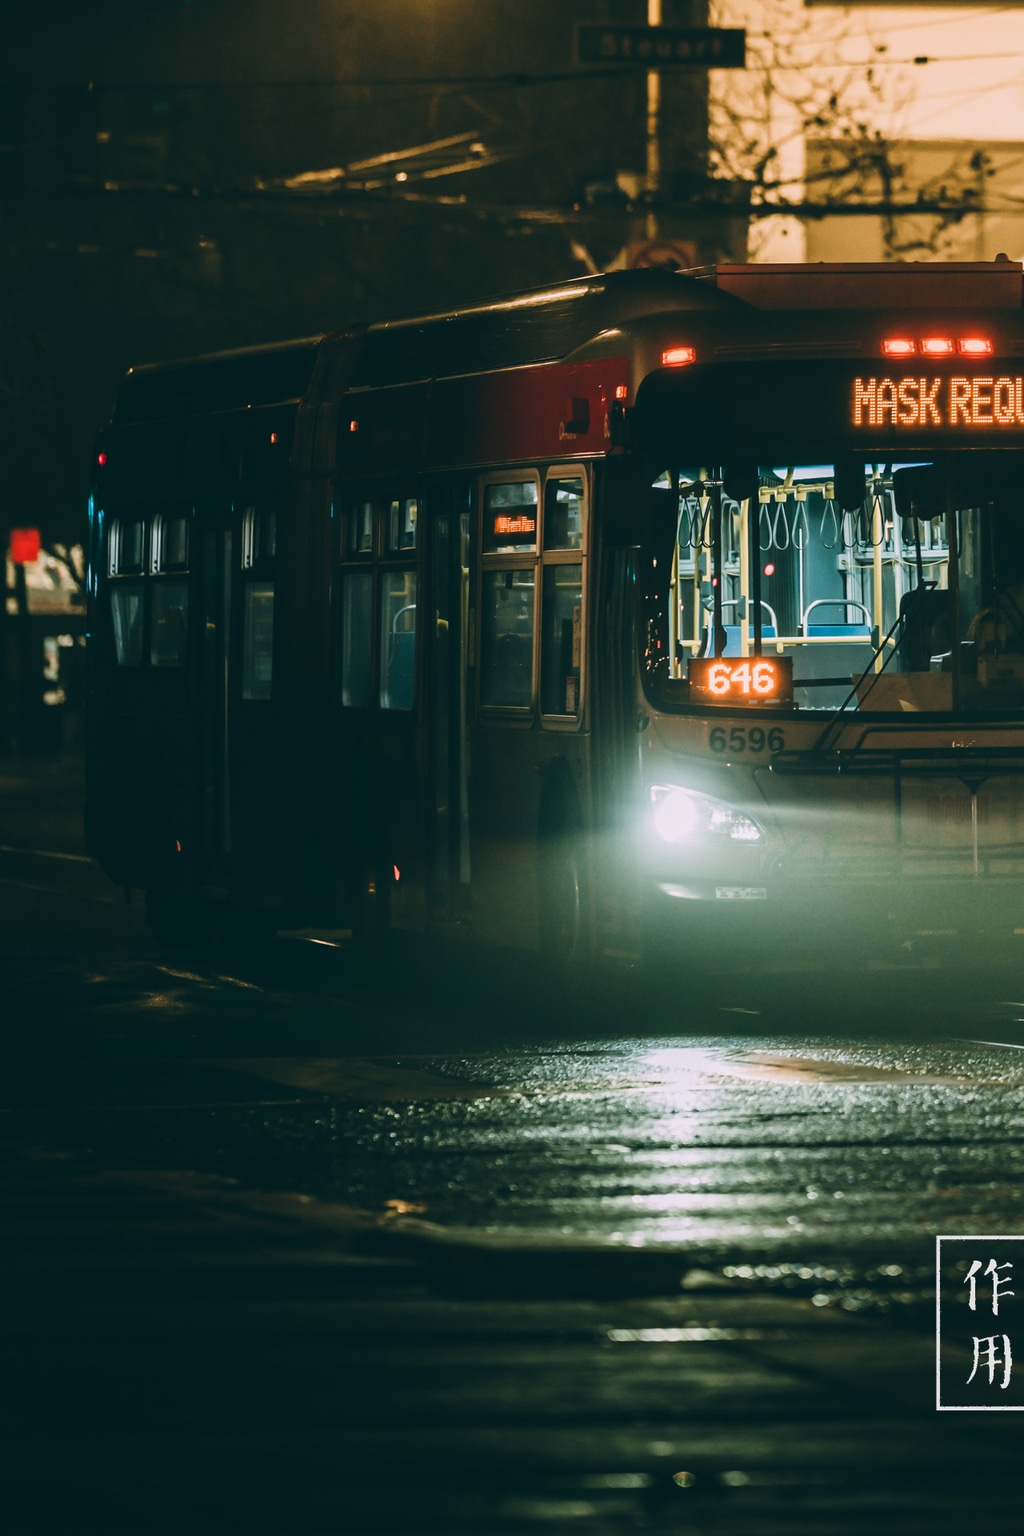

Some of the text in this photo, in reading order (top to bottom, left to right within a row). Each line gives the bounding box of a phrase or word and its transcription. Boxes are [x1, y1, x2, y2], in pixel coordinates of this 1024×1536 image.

[854, 377, 941, 424] MASK
[708, 663, 775, 694] 646
[708, 726, 785, 753] 6596
